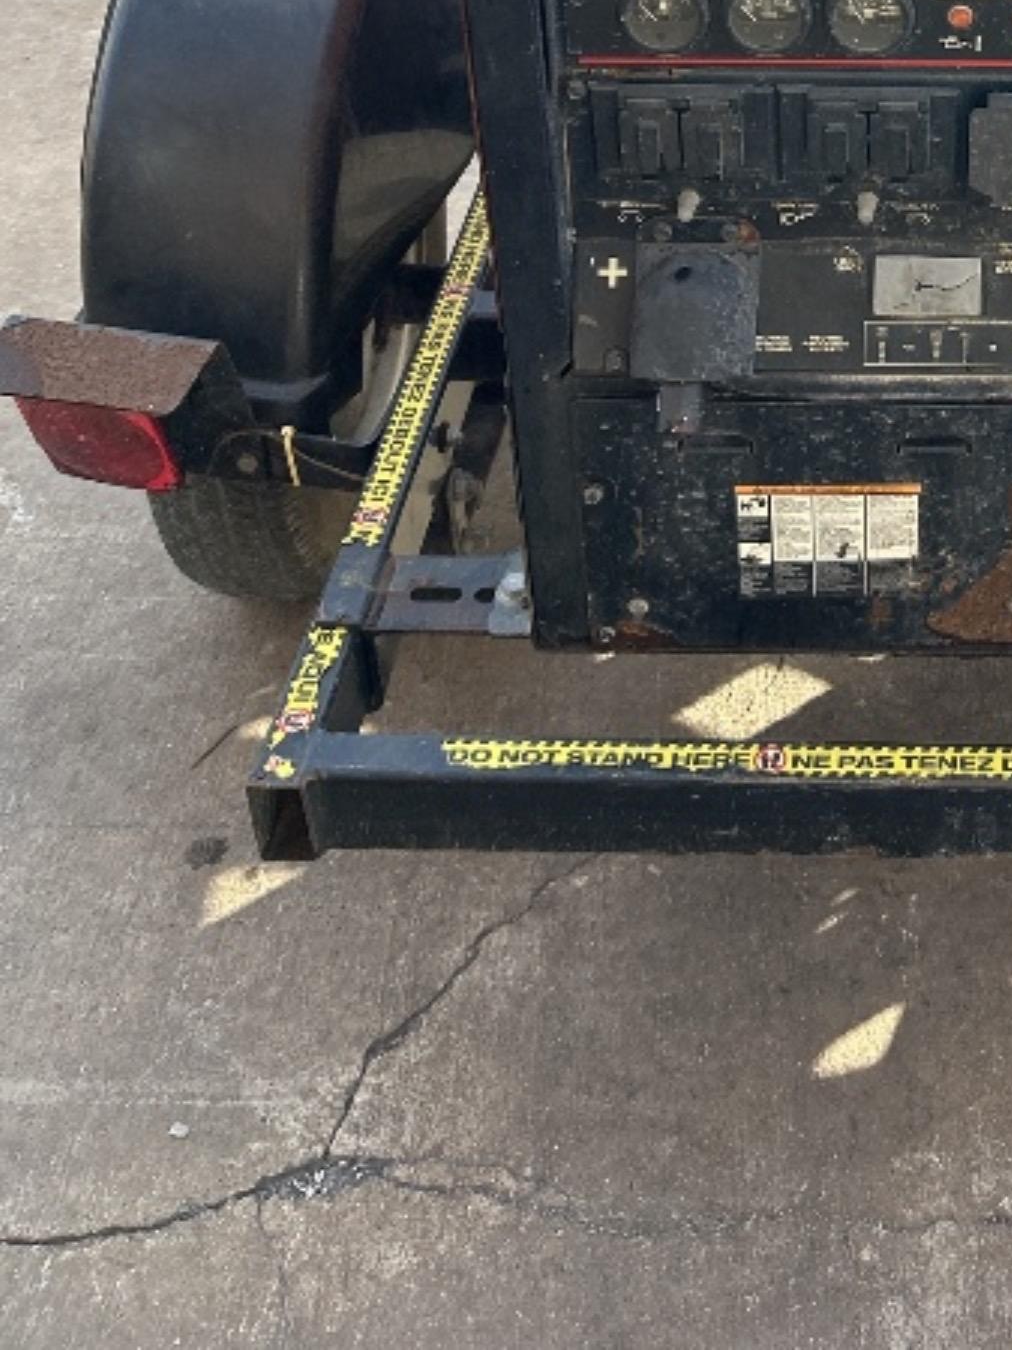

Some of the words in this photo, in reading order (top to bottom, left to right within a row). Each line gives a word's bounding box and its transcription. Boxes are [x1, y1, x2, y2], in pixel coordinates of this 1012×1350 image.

[450, 749, 492, 763] DO
[500, 750, 560, 764] NOT
[566, 752, 663, 766] STAND
[791, 755, 832, 769] NE
[838, 755, 895, 769] PAS
[900, 756, 995, 771] TENEZ
